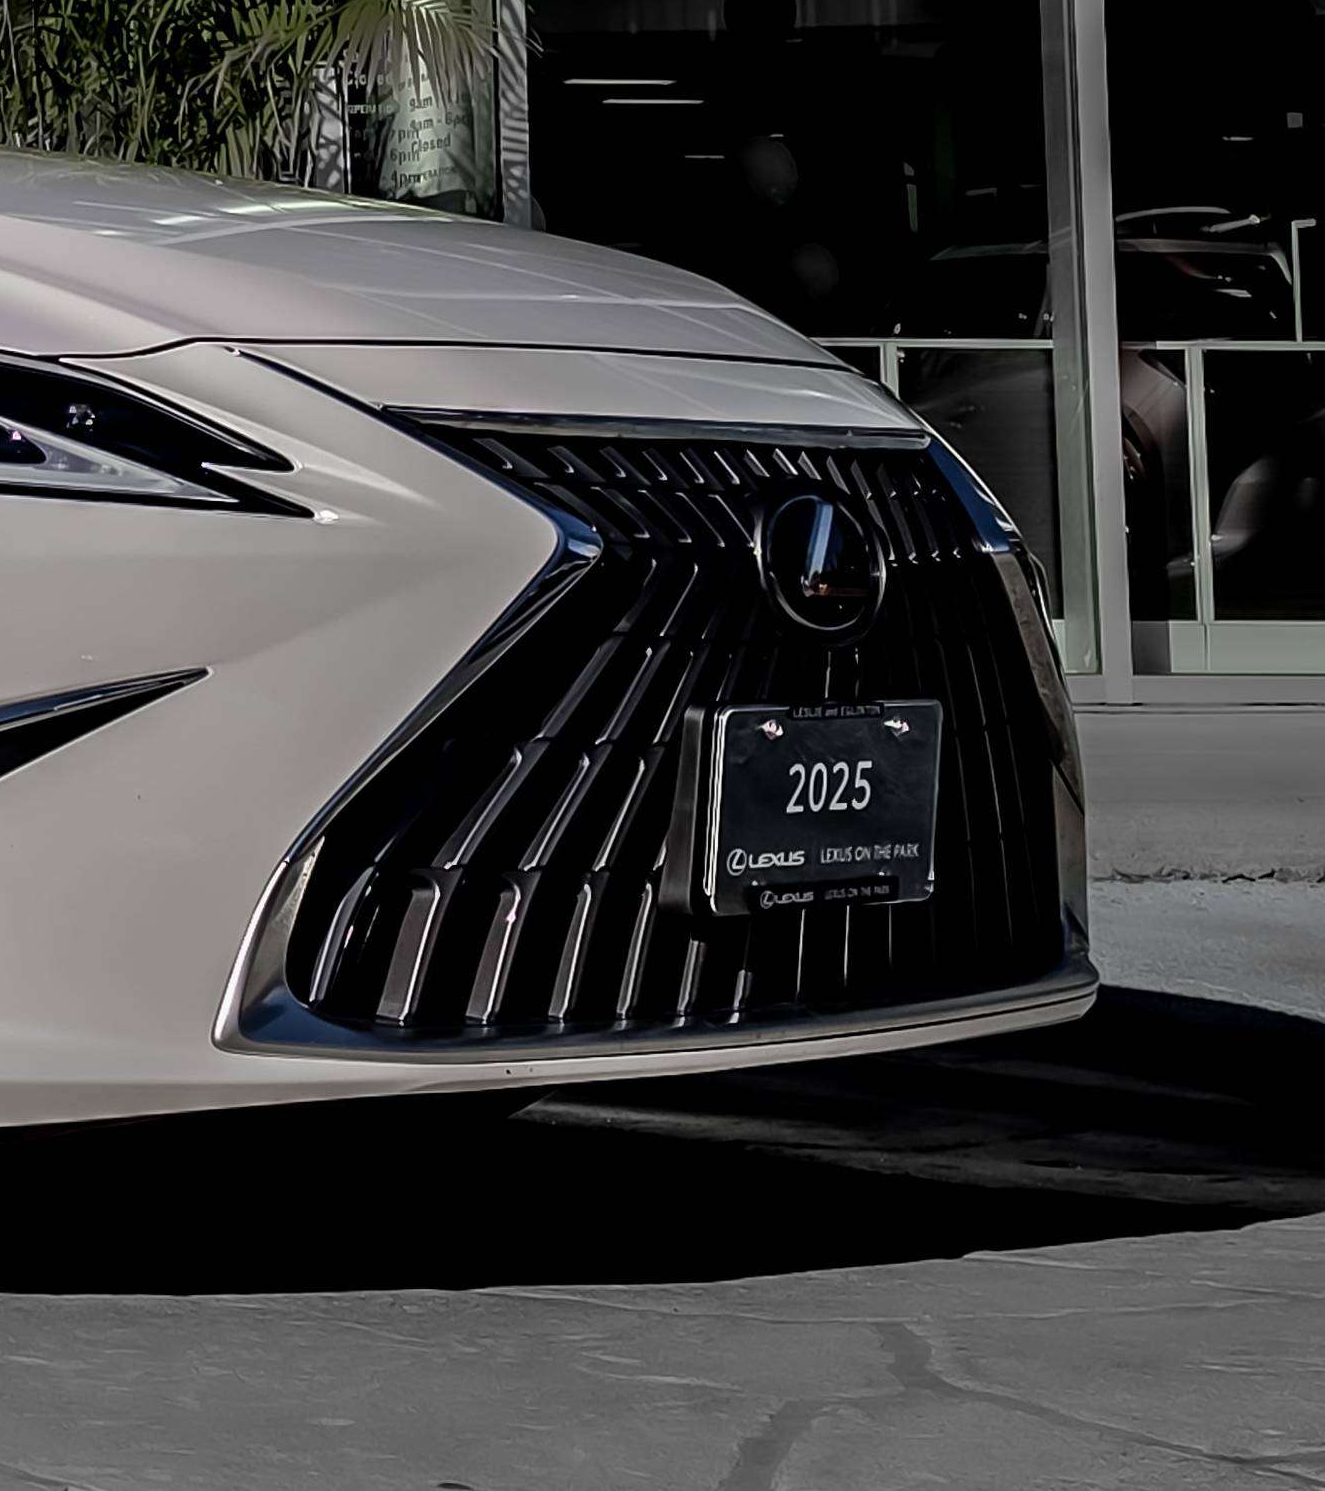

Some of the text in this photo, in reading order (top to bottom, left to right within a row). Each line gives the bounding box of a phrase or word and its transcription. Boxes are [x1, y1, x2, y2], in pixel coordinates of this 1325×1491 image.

[786, 760, 873, 813] 2025
[748, 842, 919, 869] LEXUS LEXUS ON THE PARK
[773, 891, 814, 905] LEXUS
